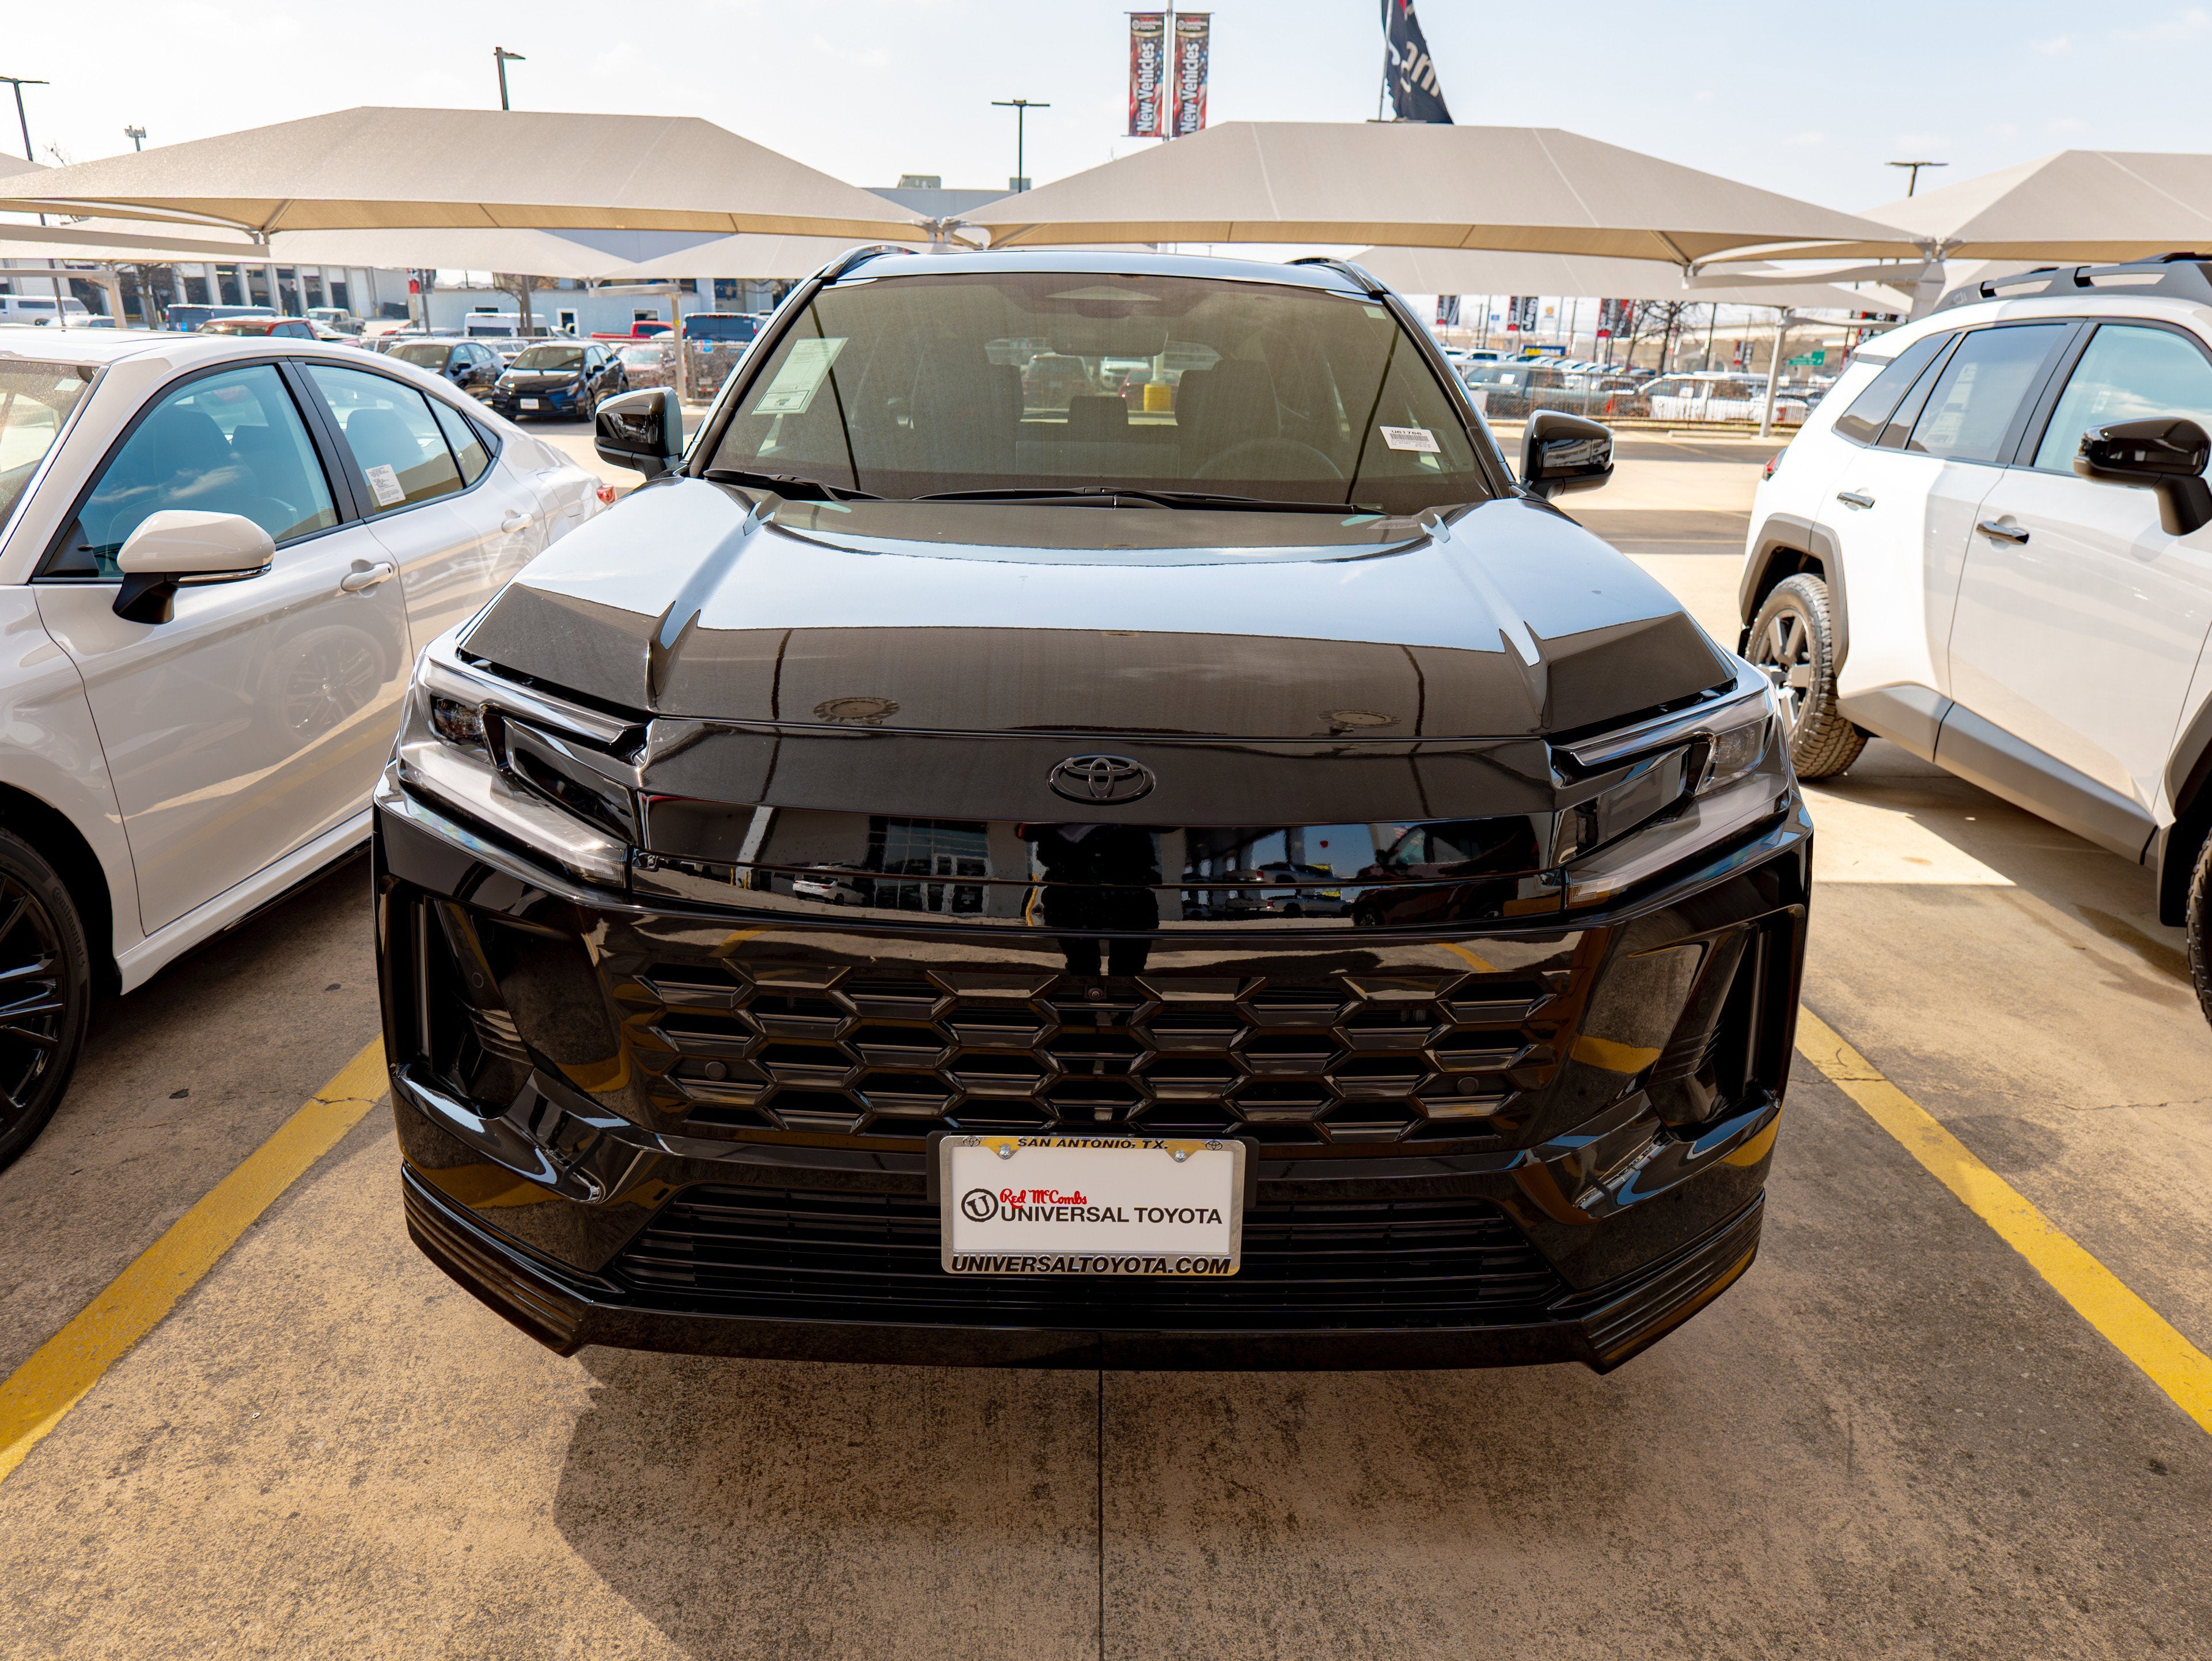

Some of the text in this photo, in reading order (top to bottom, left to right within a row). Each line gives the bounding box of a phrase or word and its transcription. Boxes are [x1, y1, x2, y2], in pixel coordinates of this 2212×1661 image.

[1138, 43, 1155, 100] Vehicles
[1181, 43, 1199, 101] Vehicles
[1137, 101, 1153, 132] New
[1180, 101, 1197, 133] New
[1017, 1137, 1051, 1147] SAN
[1142, 1138, 1169, 1149] TX.
[999, 1188, 1087, 1209] Red McCombs
[1001, 1206, 1222, 1224] UNIVERSAL TOYOTA
[951, 1254, 1232, 1274] UNIVERSALTOYOTA.COM
